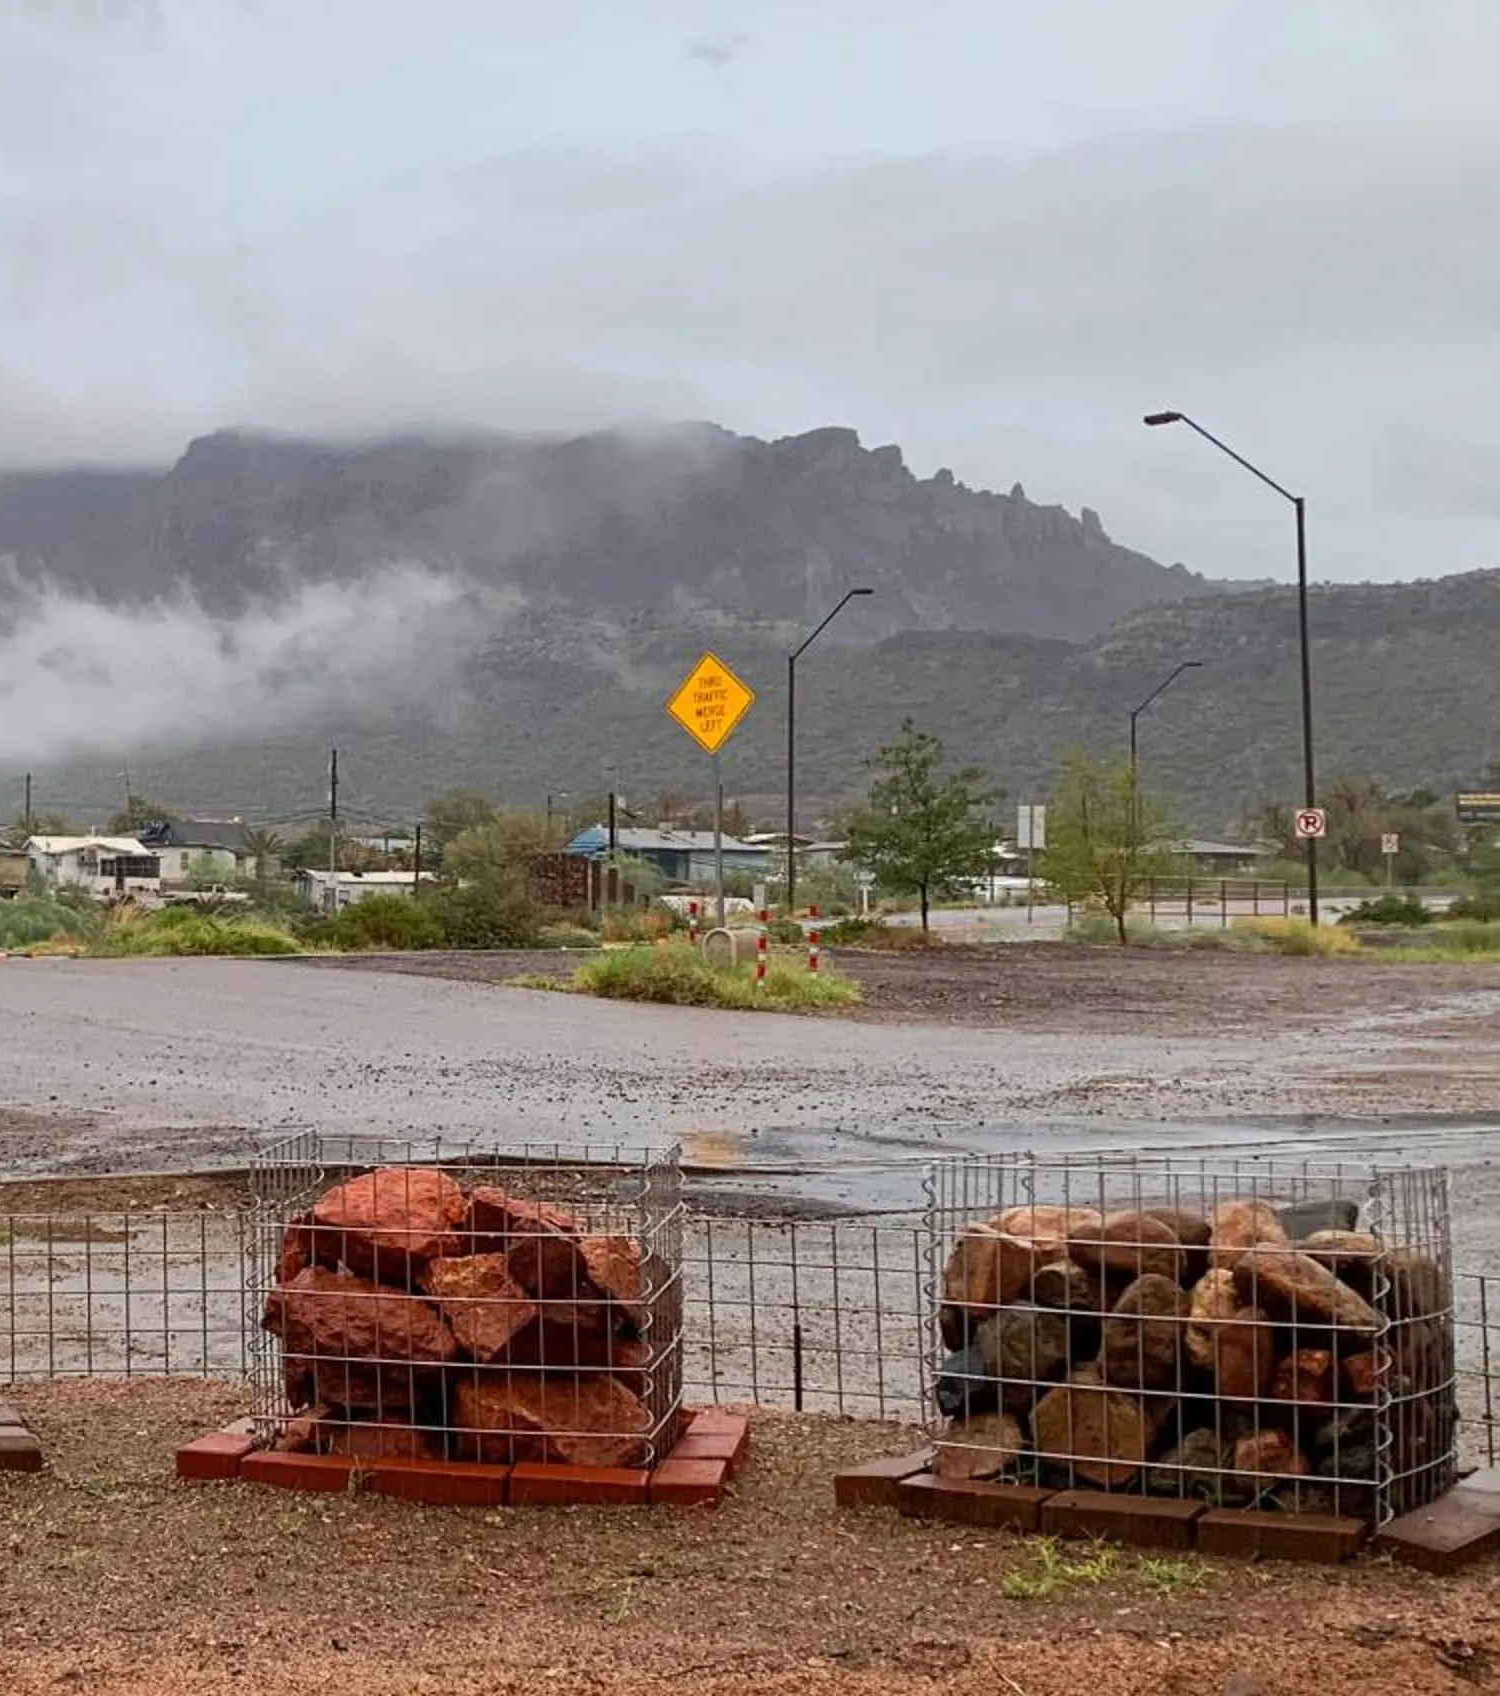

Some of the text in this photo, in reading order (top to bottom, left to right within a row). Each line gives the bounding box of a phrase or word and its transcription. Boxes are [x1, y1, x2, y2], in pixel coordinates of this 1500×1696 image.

[693, 689, 728, 704] TRAFFIC
[695, 704, 725, 718] MERGE
[700, 719, 722, 733] LEFT
